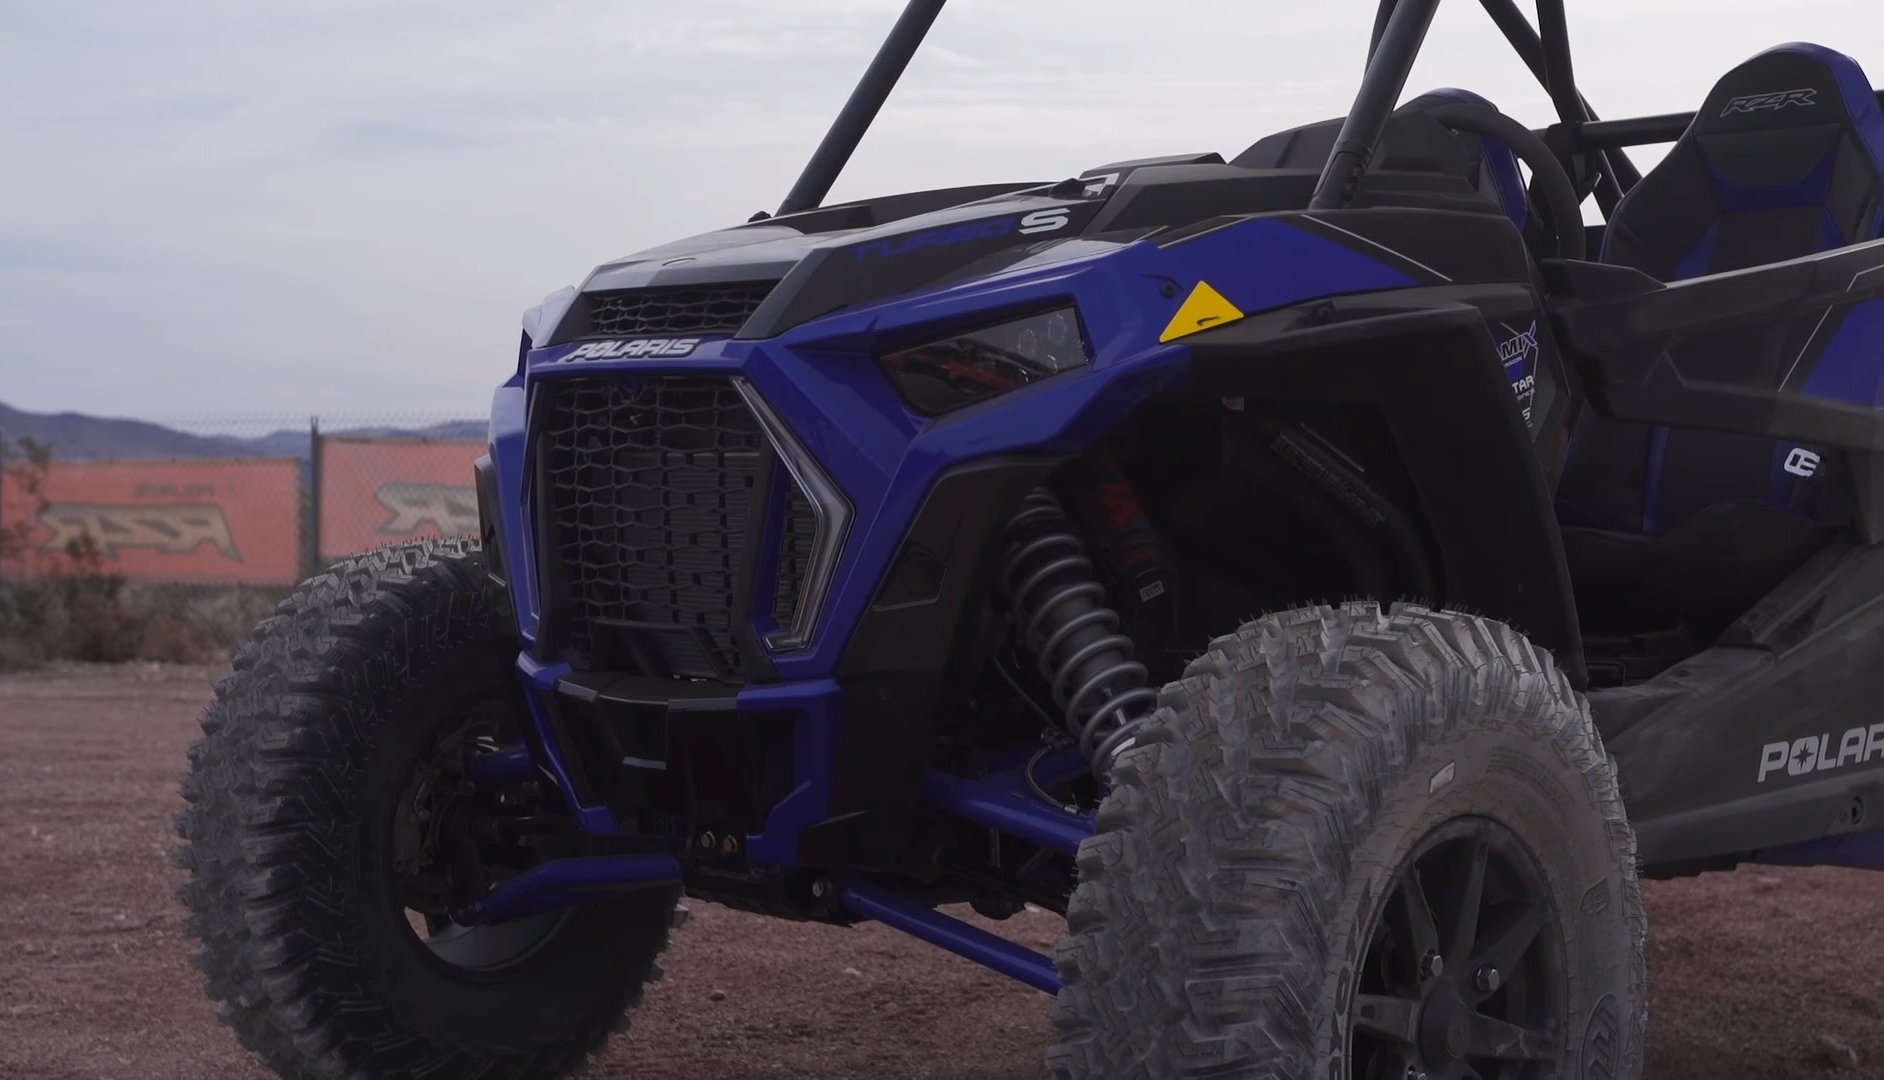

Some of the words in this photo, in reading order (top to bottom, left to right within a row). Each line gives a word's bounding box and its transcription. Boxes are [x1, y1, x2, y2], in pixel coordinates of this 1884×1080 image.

[1720, 88, 1818, 117] RZR
[852, 217, 1013, 261] TURBO
[1018, 206, 1072, 235] S
[566, 338, 701, 362] POLARIS
